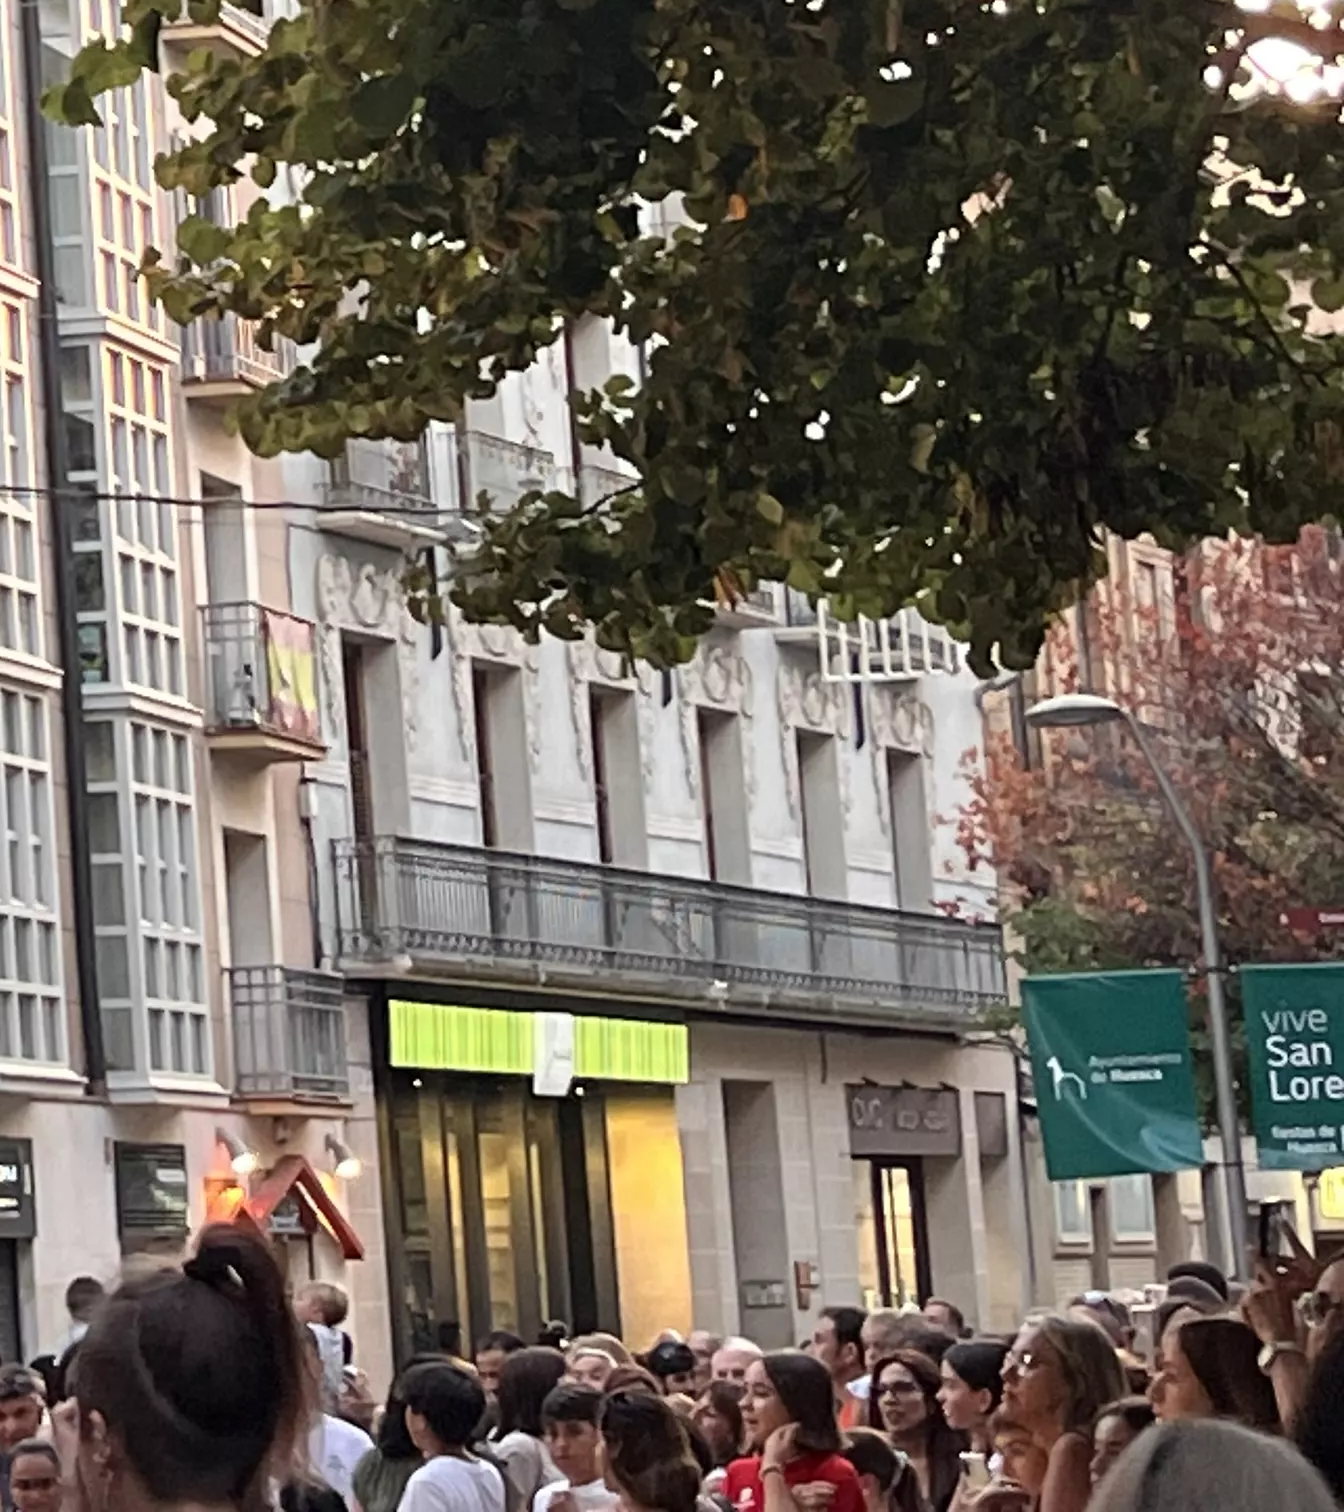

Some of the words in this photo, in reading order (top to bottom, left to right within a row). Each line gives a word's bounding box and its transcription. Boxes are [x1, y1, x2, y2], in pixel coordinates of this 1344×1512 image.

[1261, 1000, 1328, 1034] vive
[1266, 1035, 1333, 1068] San
[1269, 1070, 1344, 1102] Lore
